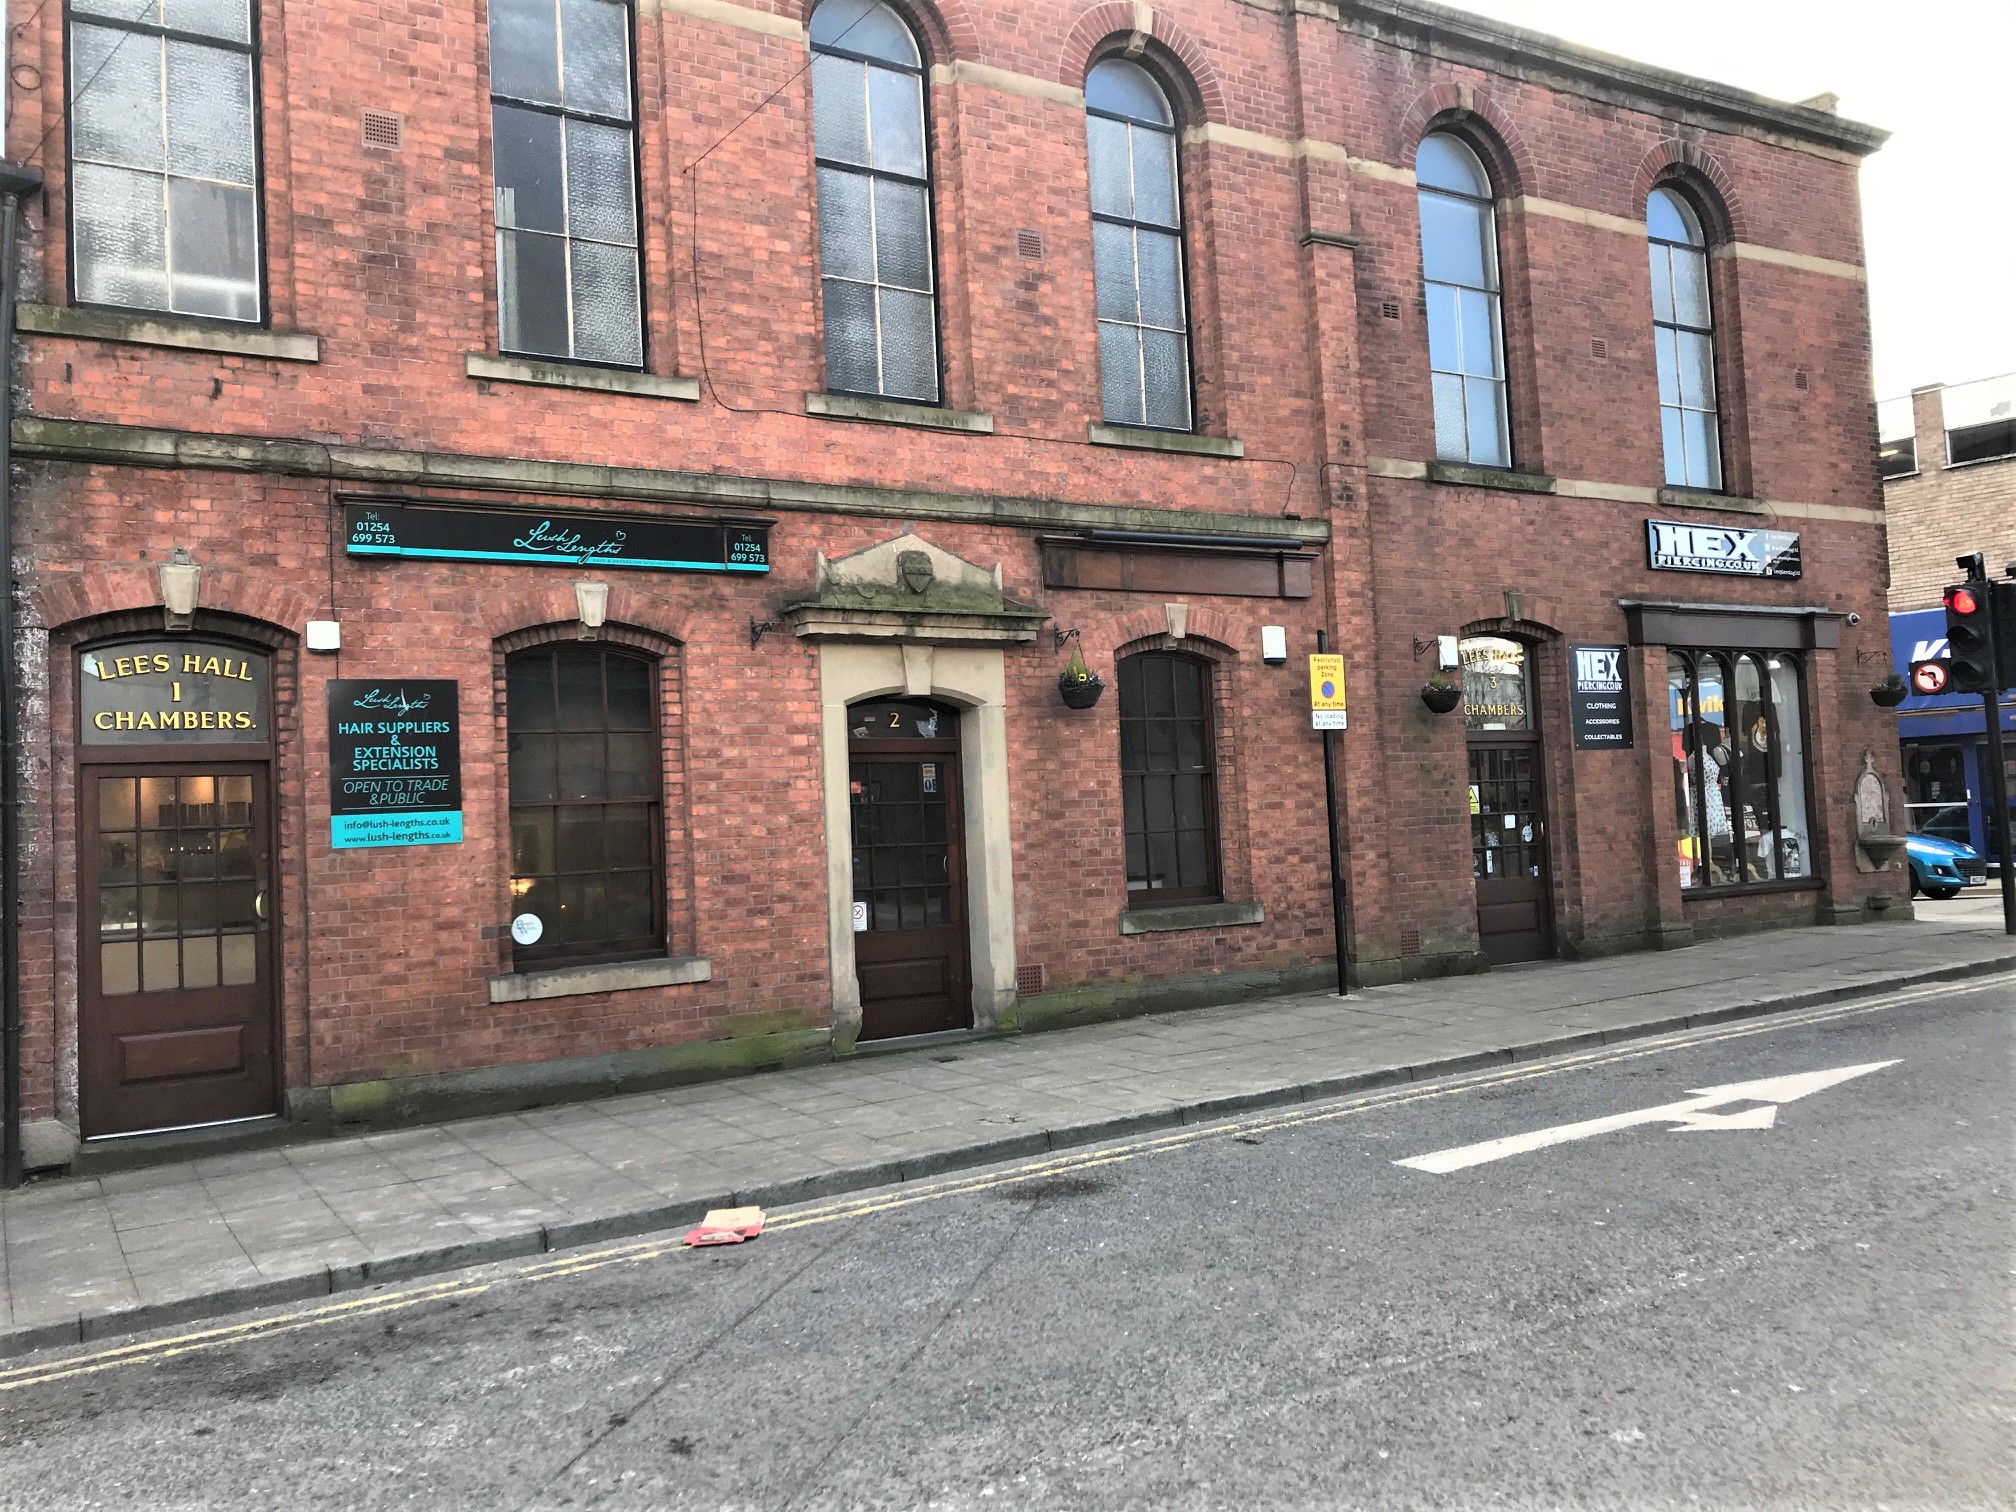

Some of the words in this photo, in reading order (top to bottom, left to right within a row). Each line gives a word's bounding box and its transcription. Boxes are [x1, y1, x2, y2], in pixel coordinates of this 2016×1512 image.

[366, 511, 380, 521] Tel:
[356, 521, 390, 532] 01254
[352, 533, 373, 543] 699
[375, 534, 396, 544] 573
[513, 520, 570, 551] Lush
[556, 533, 625, 565] Lengths
[741, 533, 753, 542] Tel:
[1652, 524, 1760, 562] HEX
[734, 543, 761, 552] 01254
[731, 553, 747, 562] 699
[749, 553, 765, 563] 573
[1461, 649, 1491, 665] LEES
[96, 653, 171, 681] LEES
[182, 653, 253, 682] HALL
[1575, 650, 1622, 682] HEX
[1490, 676, 1497, 689] 3
[353, 688, 392, 709] Lush
[383, 696, 430, 717] Lengths
[1586, 702, 1617, 710] CLOTHING
[1464, 704, 1527, 716] CHAMBERS.
[94, 711, 257, 730] CHAMBERS.
[889, 712, 900, 728] 2
[338, 722, 374, 735] HAIR
[378, 721, 450, 734] SUPPLIERS
[390, 734, 401, 746] &
[354, 746, 436, 759] EXTENSION
[353, 758, 439, 771] SPECIALISTS
[343, 781, 382, 794] OPEN
[385, 780, 403, 792] TO
[404, 778, 450, 792] TRADE
[344, 818, 450, 830] info@lush-lengths.co.uk
[344, 831, 451, 842] www.lush-lengths.co.uk
